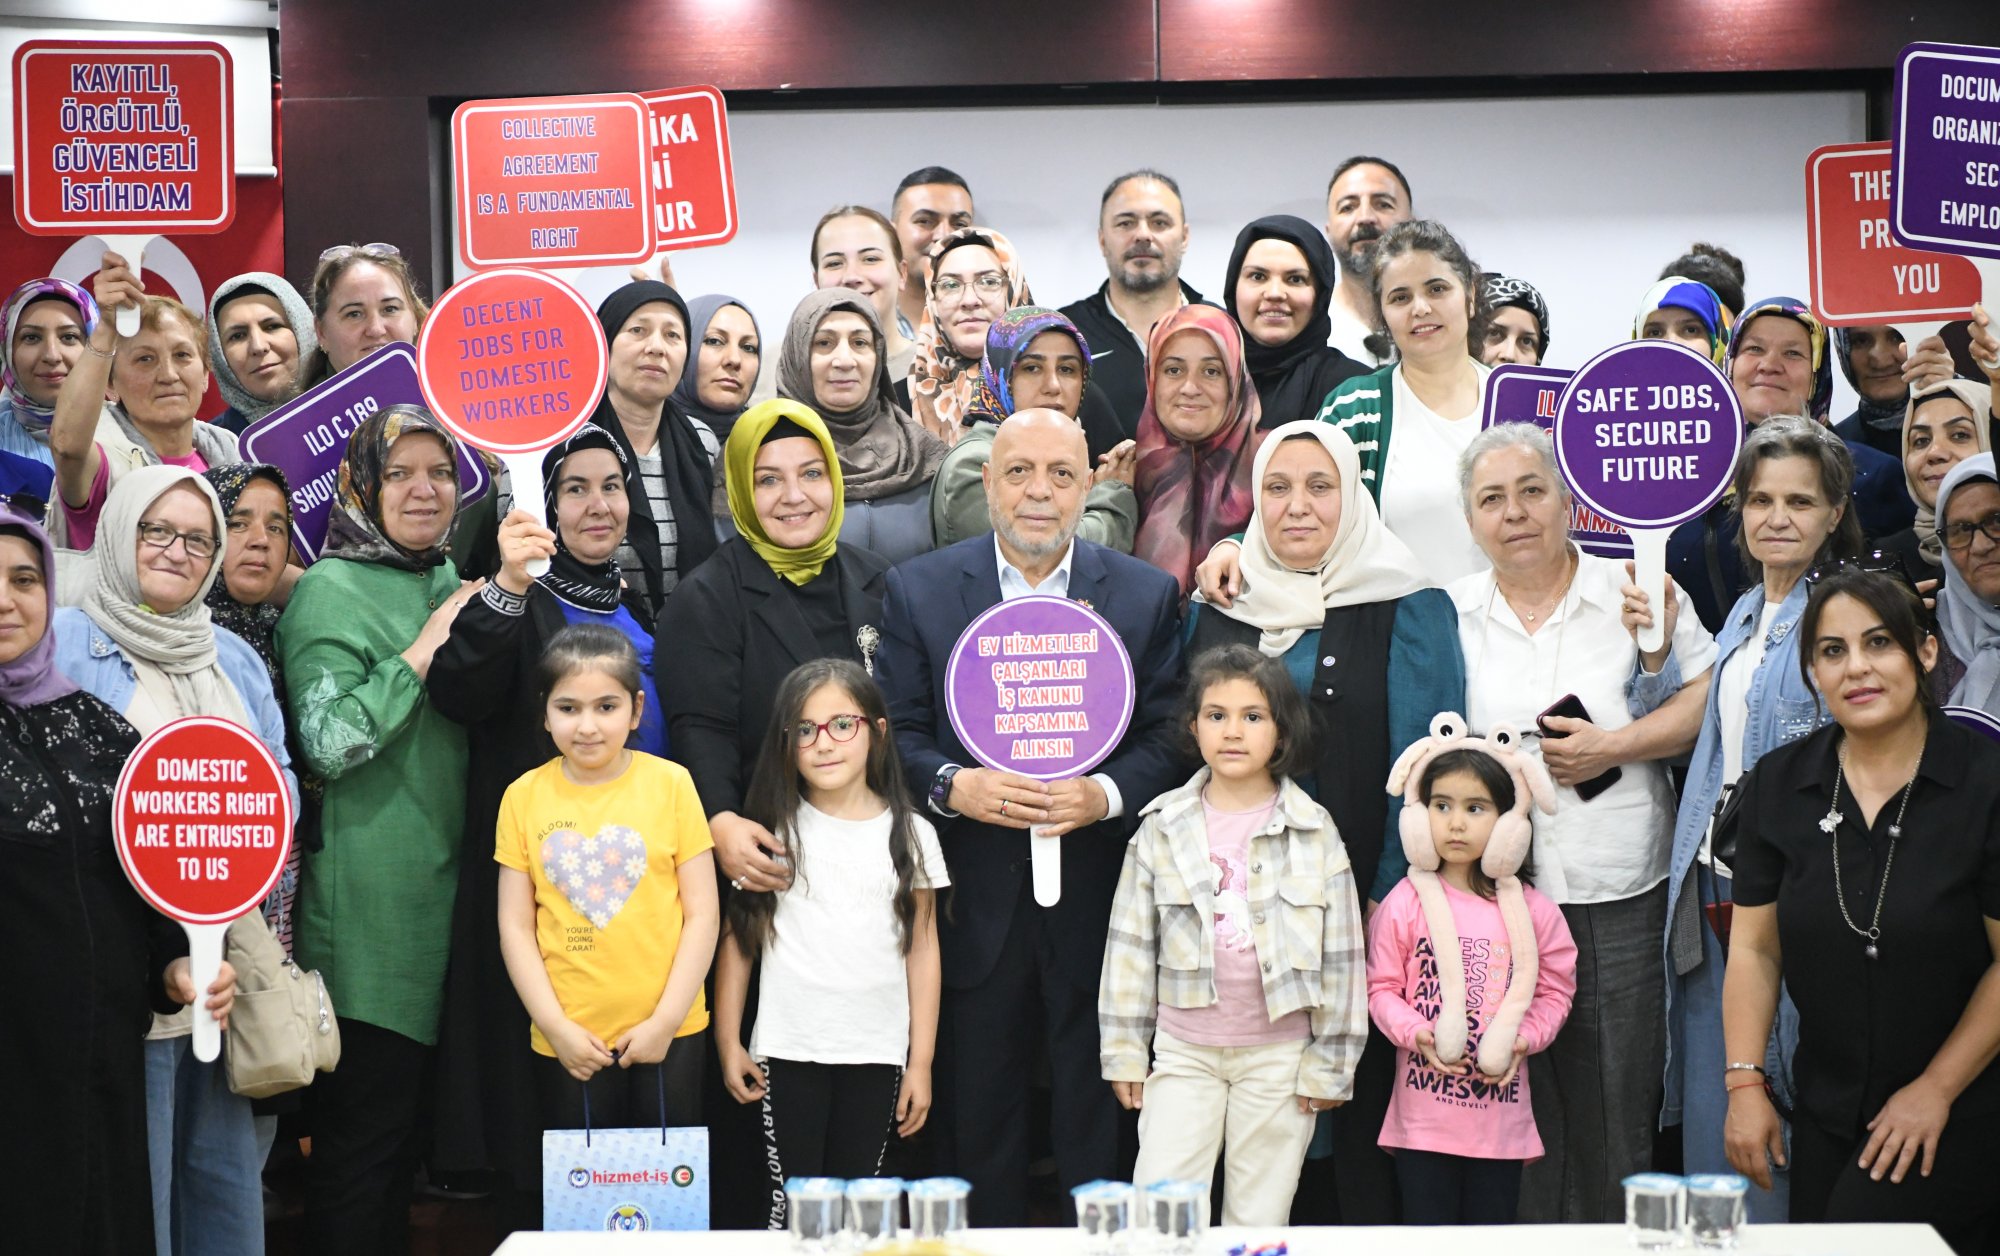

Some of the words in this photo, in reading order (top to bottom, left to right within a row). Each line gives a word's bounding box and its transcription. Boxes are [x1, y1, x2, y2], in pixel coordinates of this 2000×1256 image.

[71, 64, 178, 95] KAYITLI,
[61, 99, 189, 136] ÖRGÜTLÜ,
[502, 116, 596, 139] COLLECTIVE
[53, 137, 198, 172] GÜVENCELİ
[502, 153, 598, 176] AGREEMENT
[62, 177, 191, 212] İSTİHDAM
[477, 194, 493, 215] IS
[498, 194, 508, 214] A
[518, 189, 634, 213] FUNDAMENTAL
[531, 227, 578, 249] RIGHT
[1892, 262, 1940, 295] YOU
[463, 297, 544, 327] DECENT
[457, 333, 514, 360] JOBS
[522, 327, 564, 351] FOR
[460, 359, 571, 392] DOMESTIC
[462, 391, 571, 424] WORKERS
[1576, 387, 1639, 413] SAFE
[1647, 384, 1720, 411] JOBS,
[302, 424, 335, 456] ILO
[331, 415, 350, 439] C
[345, 396, 378, 429] 189
[1595, 419, 1711, 448] SECURED
[1602, 455, 1699, 483] FUTURE
[978, 636, 1000, 656] EV
[1003, 629, 1098, 655] HİZMETLERİ
[992, 659, 1087, 684] ÇALŞANLARI
[998, 684, 1015, 711] İŞ
[1018, 686, 1083, 707] KANUNU
[995, 711, 1088, 734] KAPSAMINA
[1011, 738, 1073, 760] ALINSIN
[157, 758, 247, 783] DOMESTIC
[131, 791, 220, 815] WORKERS
[225, 792, 277, 815] RIGHT
[134, 824, 169, 847] ARE
[175, 824, 275, 848] ENTRUSTED
[537, 820, 577, 841] BLOOM!
[177, 857, 200, 881] TO
[206, 857, 229, 881] US
[566, 944, 596, 952] CARAT!
[1436, 1096, 1453, 1104] AND
[1456, 1101, 1488, 1110] LOVELY
[593, 1169, 669, 1185] hizmet-iş
[767, 1145, 784, 1186] NOT
